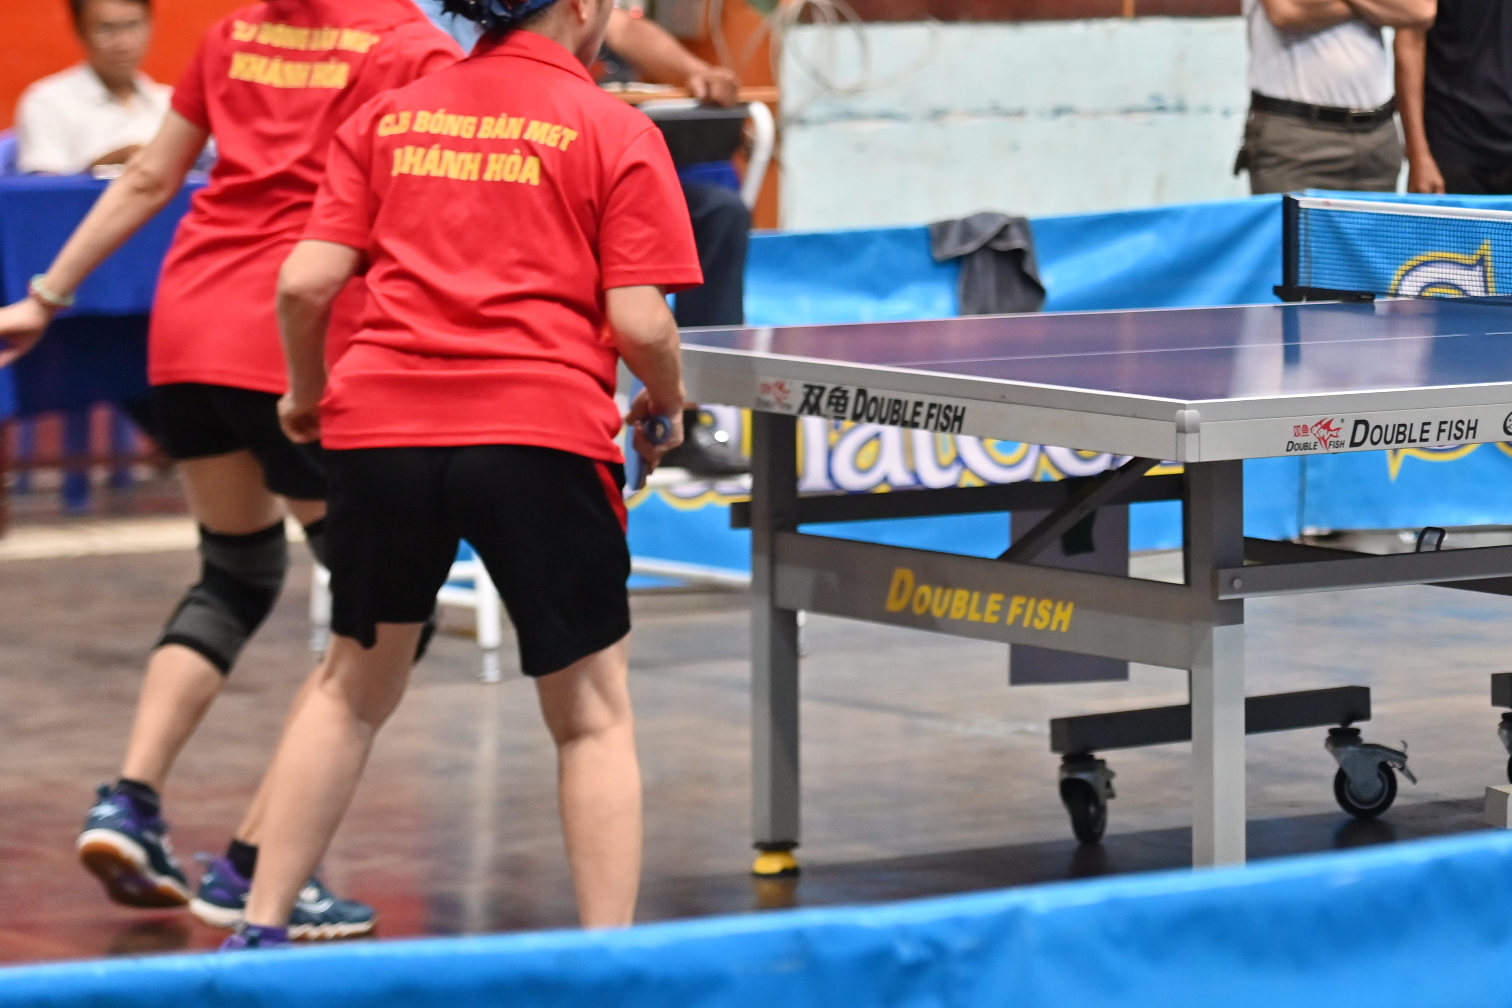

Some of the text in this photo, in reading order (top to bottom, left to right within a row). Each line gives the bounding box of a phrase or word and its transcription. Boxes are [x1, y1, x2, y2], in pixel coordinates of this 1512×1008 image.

[411, 108, 478, 139] BÓNG
[476, 113, 525, 140] BÀN
[482, 148, 541, 186] HÒA
[851, 388, 924, 428] DOUBLE
[922, 401, 966, 434] FISH
[1349, 418, 1479, 448] DOUBLE FISH
[885, 567, 1076, 633] DOUBLE FISH
